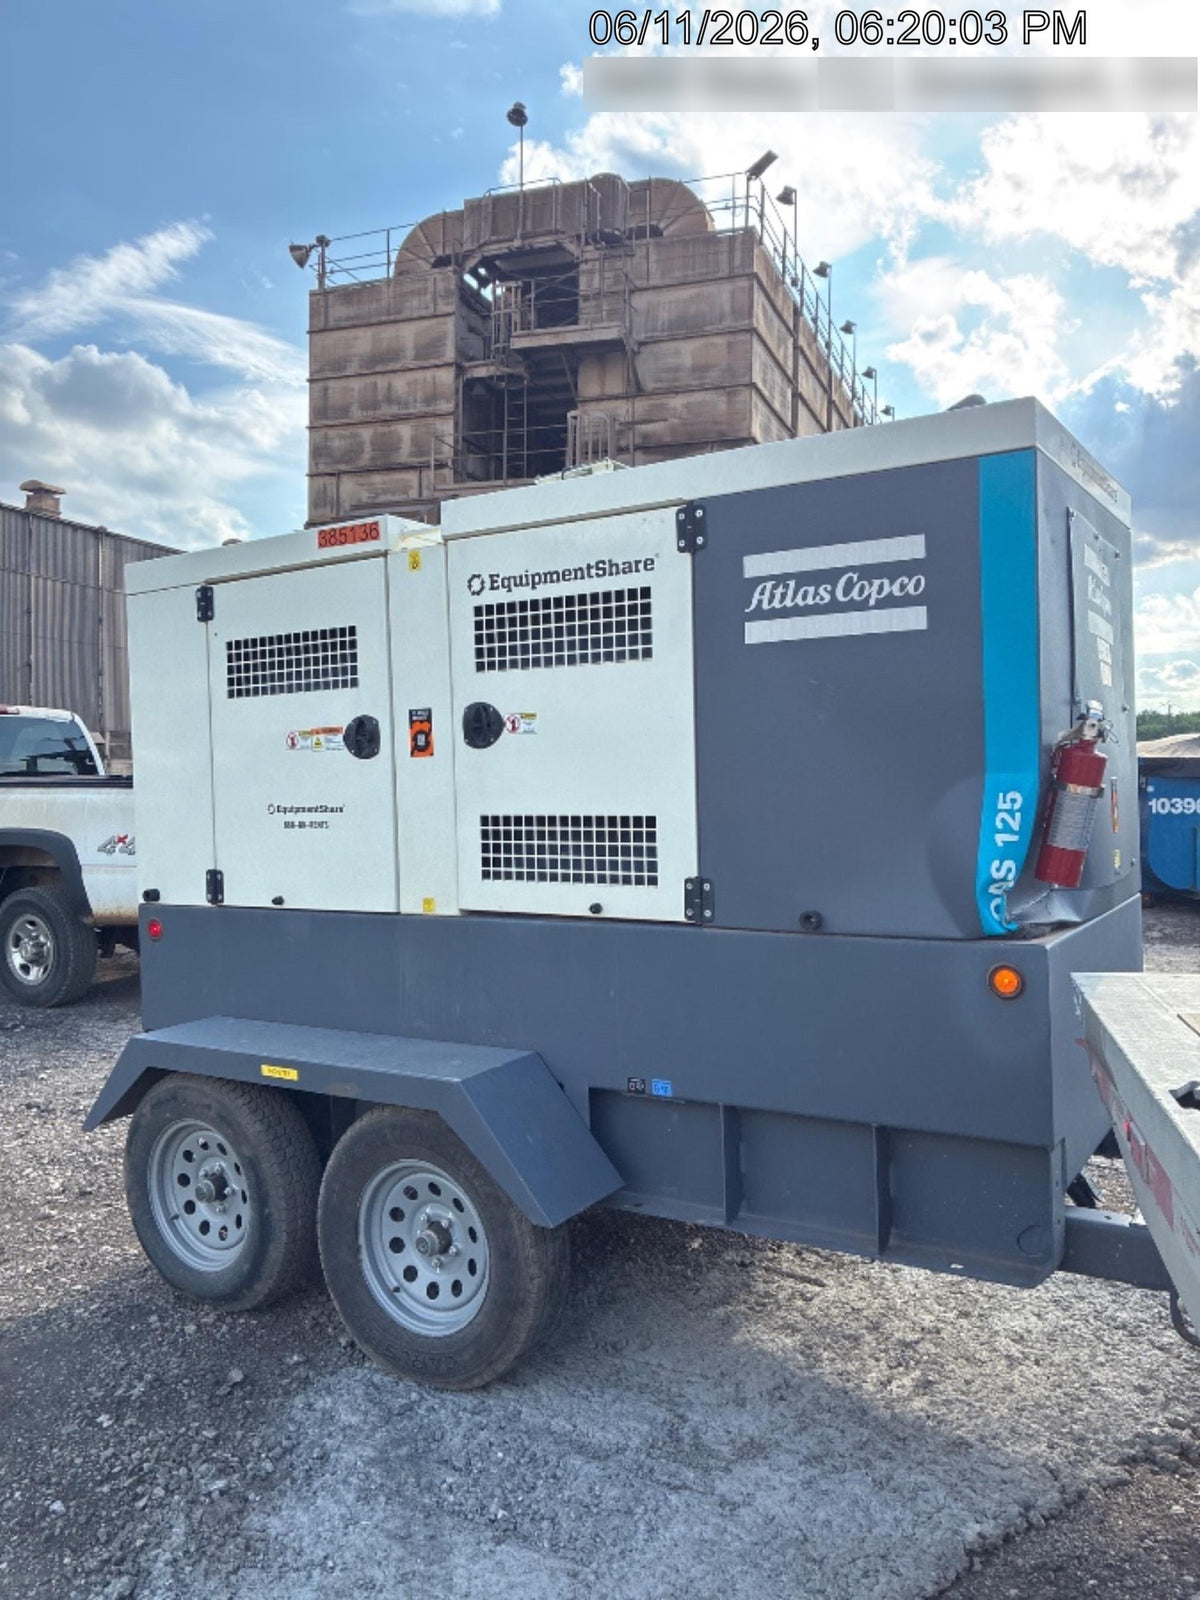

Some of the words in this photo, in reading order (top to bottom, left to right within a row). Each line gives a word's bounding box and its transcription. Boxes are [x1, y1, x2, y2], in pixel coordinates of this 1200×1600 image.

[318, 522, 380, 548] 385136
[488, 555, 656, 593] EquipmentShare
[744, 578, 833, 613] Atlas
[834, 571, 926, 607] Copco
[994, 790, 1023, 848] 125
